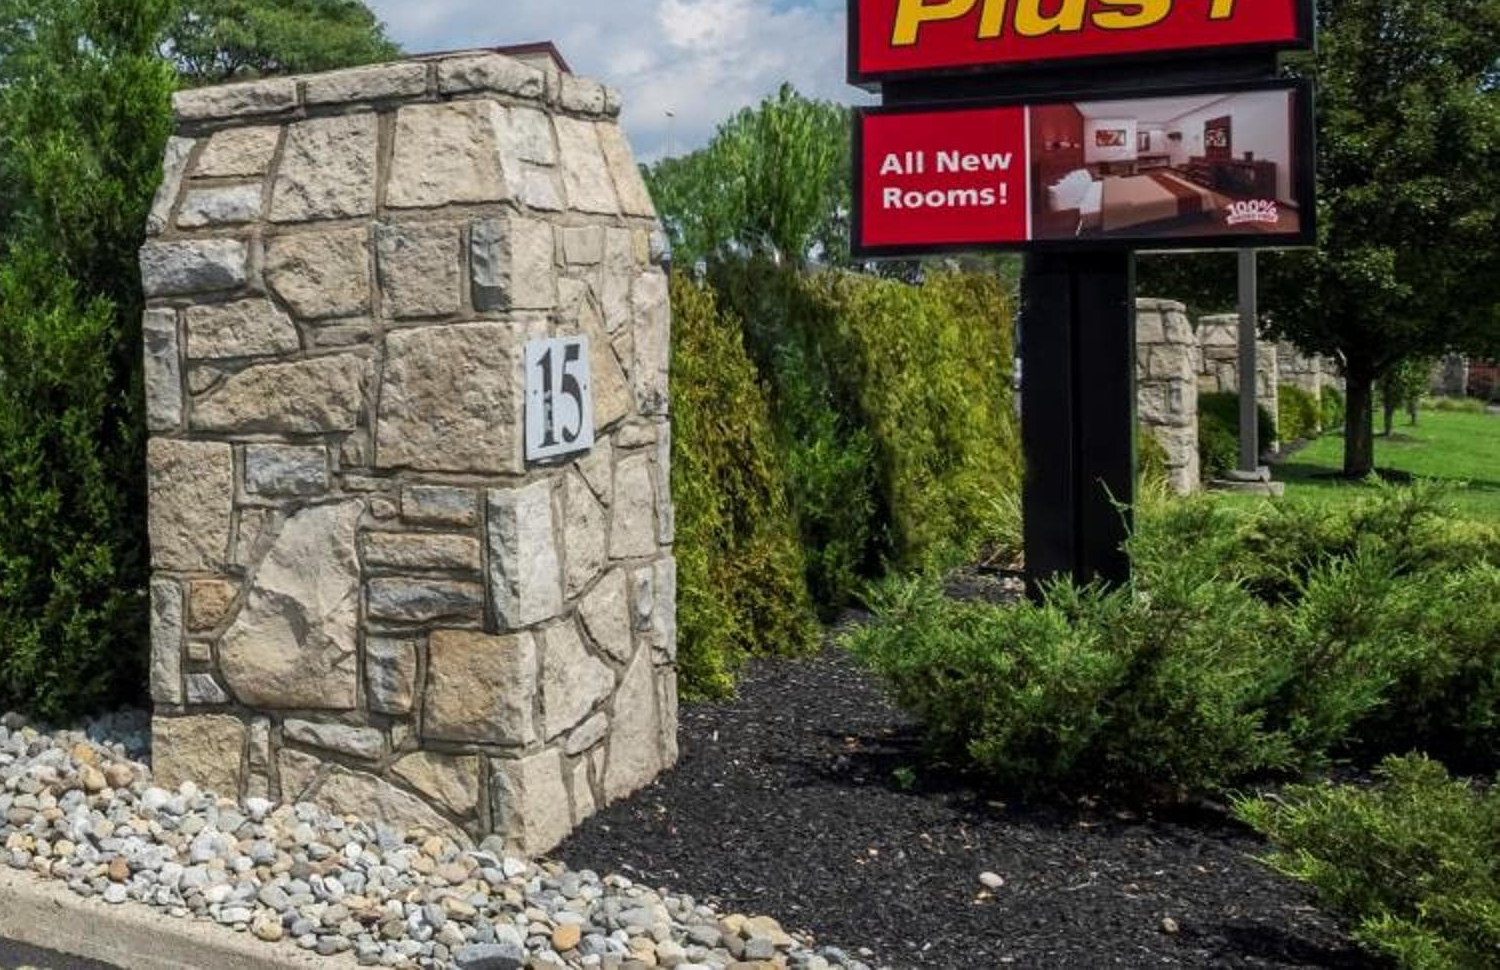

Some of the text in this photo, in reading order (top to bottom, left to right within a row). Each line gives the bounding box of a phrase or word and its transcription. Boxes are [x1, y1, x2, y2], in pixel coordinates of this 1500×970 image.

[880, 150, 1012, 175] All New
[882, 182, 1008, 209] Rooms!
[1226, 199, 1277, 217] 100%
[536, 343, 583, 448] 15
